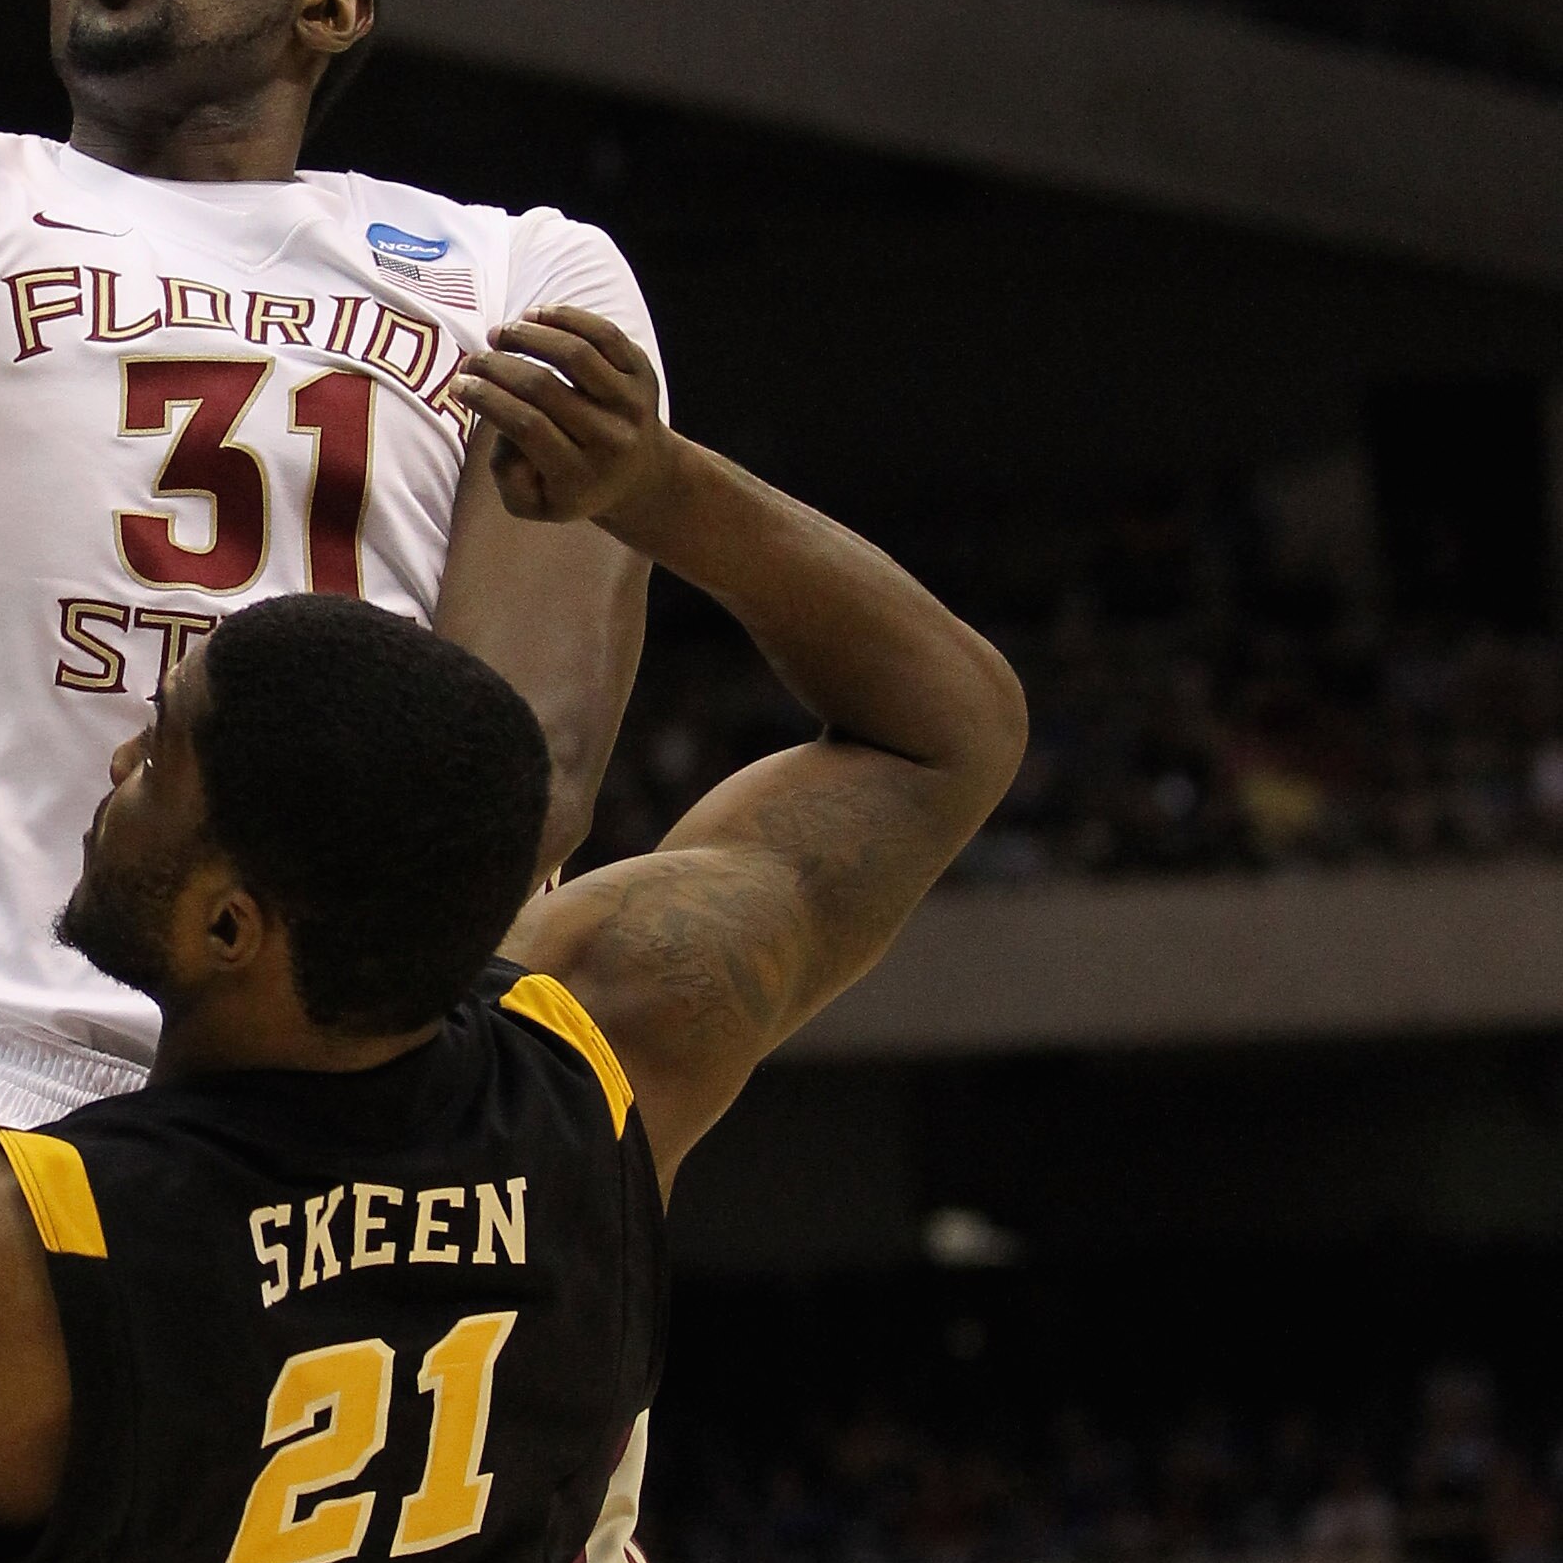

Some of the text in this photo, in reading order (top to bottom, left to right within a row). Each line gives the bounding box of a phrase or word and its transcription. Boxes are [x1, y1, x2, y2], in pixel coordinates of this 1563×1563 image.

[377, 239, 441, 254] NCAA
[112, 354, 379, 603] 31
[249, 1176, 528, 1309] SKEEN
